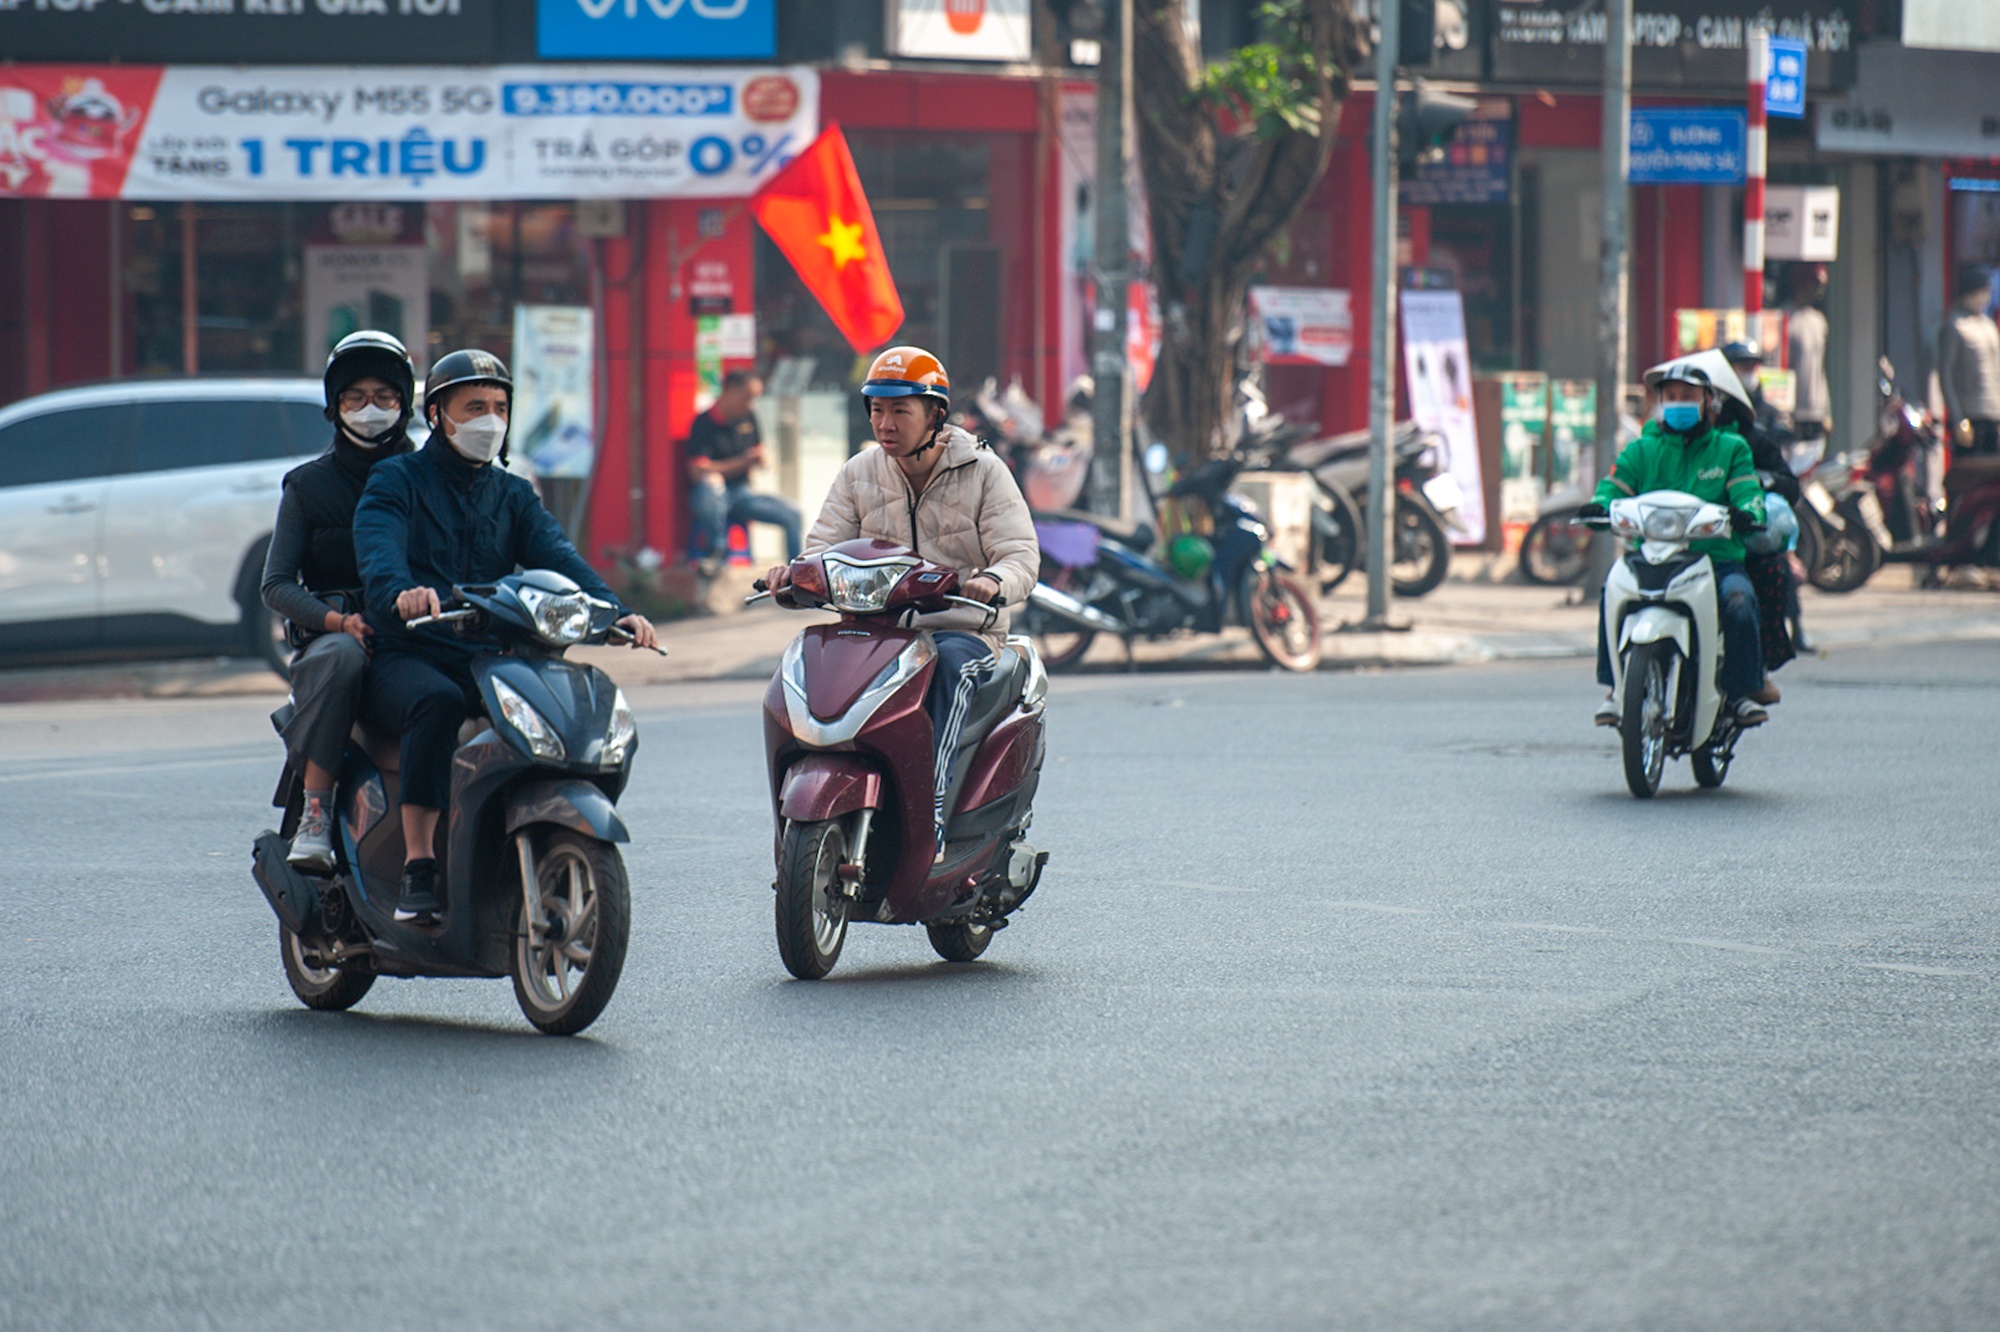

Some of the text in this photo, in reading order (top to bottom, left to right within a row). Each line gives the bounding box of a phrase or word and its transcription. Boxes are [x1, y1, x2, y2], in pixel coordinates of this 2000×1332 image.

[197, 84, 494, 123] Galaxy M55 5G
[240, 138, 265, 176] 1
[284, 126, 489, 188] TRIỆU
[609, 132, 682, 161] GÓP
[689, 132, 796, 178] 0%
